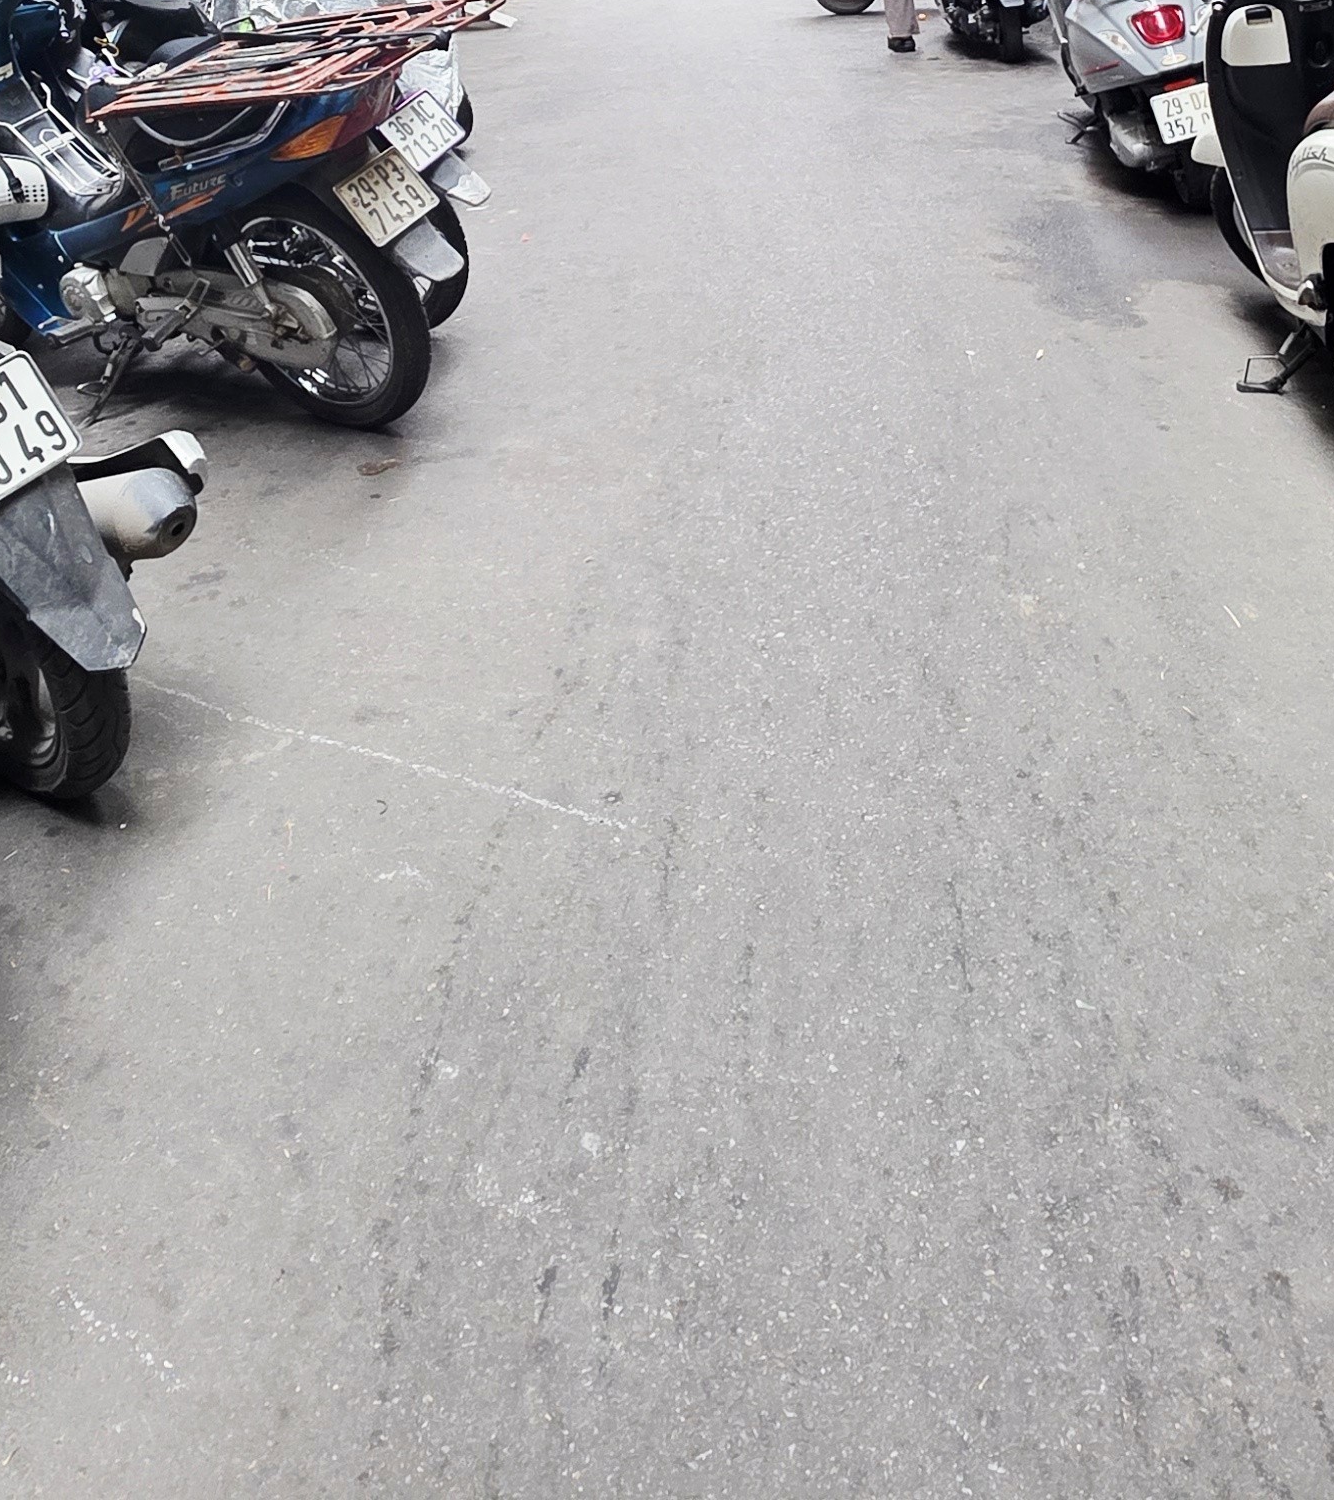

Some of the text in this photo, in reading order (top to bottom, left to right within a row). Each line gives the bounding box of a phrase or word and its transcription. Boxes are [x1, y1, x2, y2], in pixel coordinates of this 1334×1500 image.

[388, 99, 435, 142] 36-AC
[402, 117, 458, 167] 713.20
[347, 157, 406, 209] 29-P3
[368, 184, 427, 235] 7459
